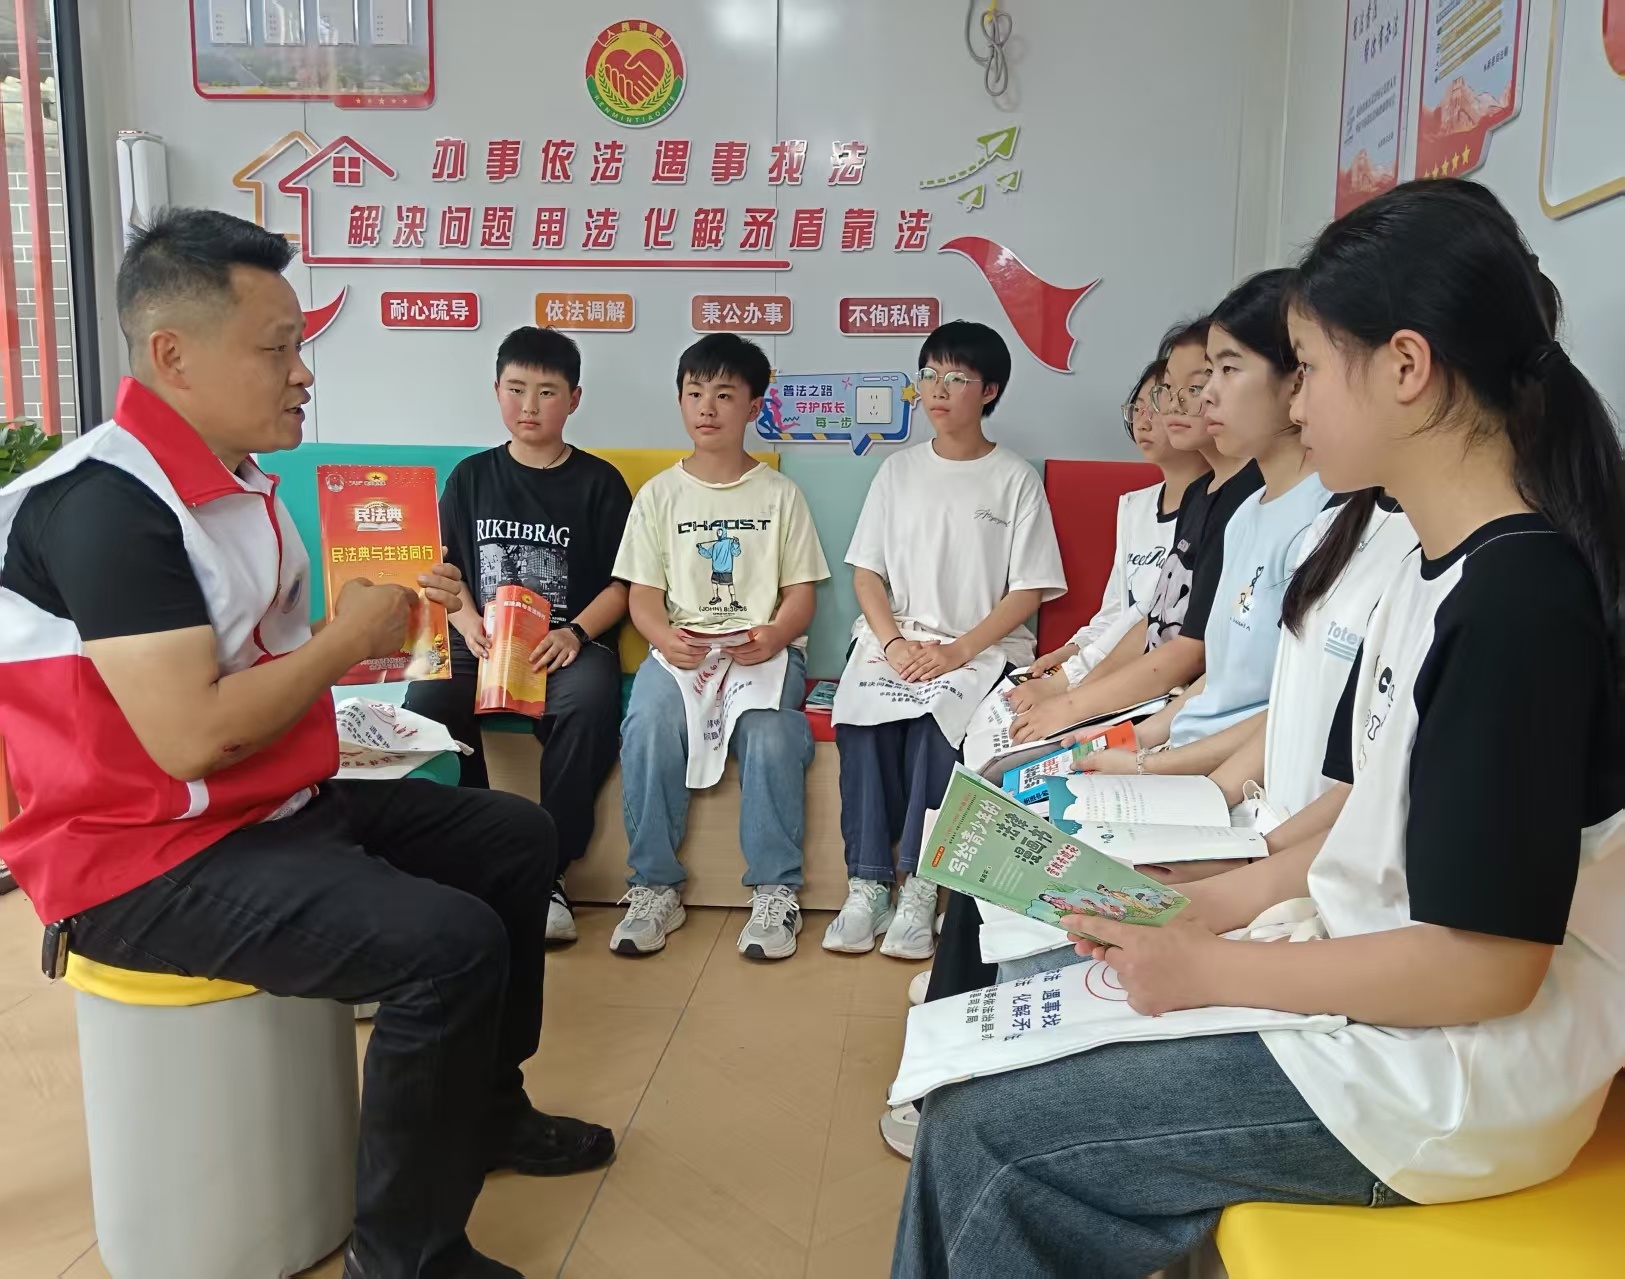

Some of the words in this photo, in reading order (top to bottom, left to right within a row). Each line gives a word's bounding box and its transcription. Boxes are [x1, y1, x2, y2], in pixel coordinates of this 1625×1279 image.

[432, 137, 626, 185] 办事依法
[651, 140, 868, 186] 遇事找法
[347, 205, 620, 250] 解决问题用法
[643, 207, 932, 252] 化解矛盾靠法
[389, 298, 470, 321] 耐心疏导
[545, 300, 626, 322] 依法调解
[702, 302, 784, 325] 秉公办事
[848, 304, 931, 327] 不徇私情
[783, 385, 833, 397] 普法之路
[796, 401, 845, 414] 守护成长
[816, 416, 852, 428] 每一步
[354, 506, 403, 523] 民法典
[476, 519, 570, 548] RIKHBRAG
[331, 545, 434, 563] 民法典与生活同行
[948, 799, 1003, 877] 写给青少年的
[995, 812, 1029, 841] 法律
[1013, 825, 1053, 866] 漫画书
